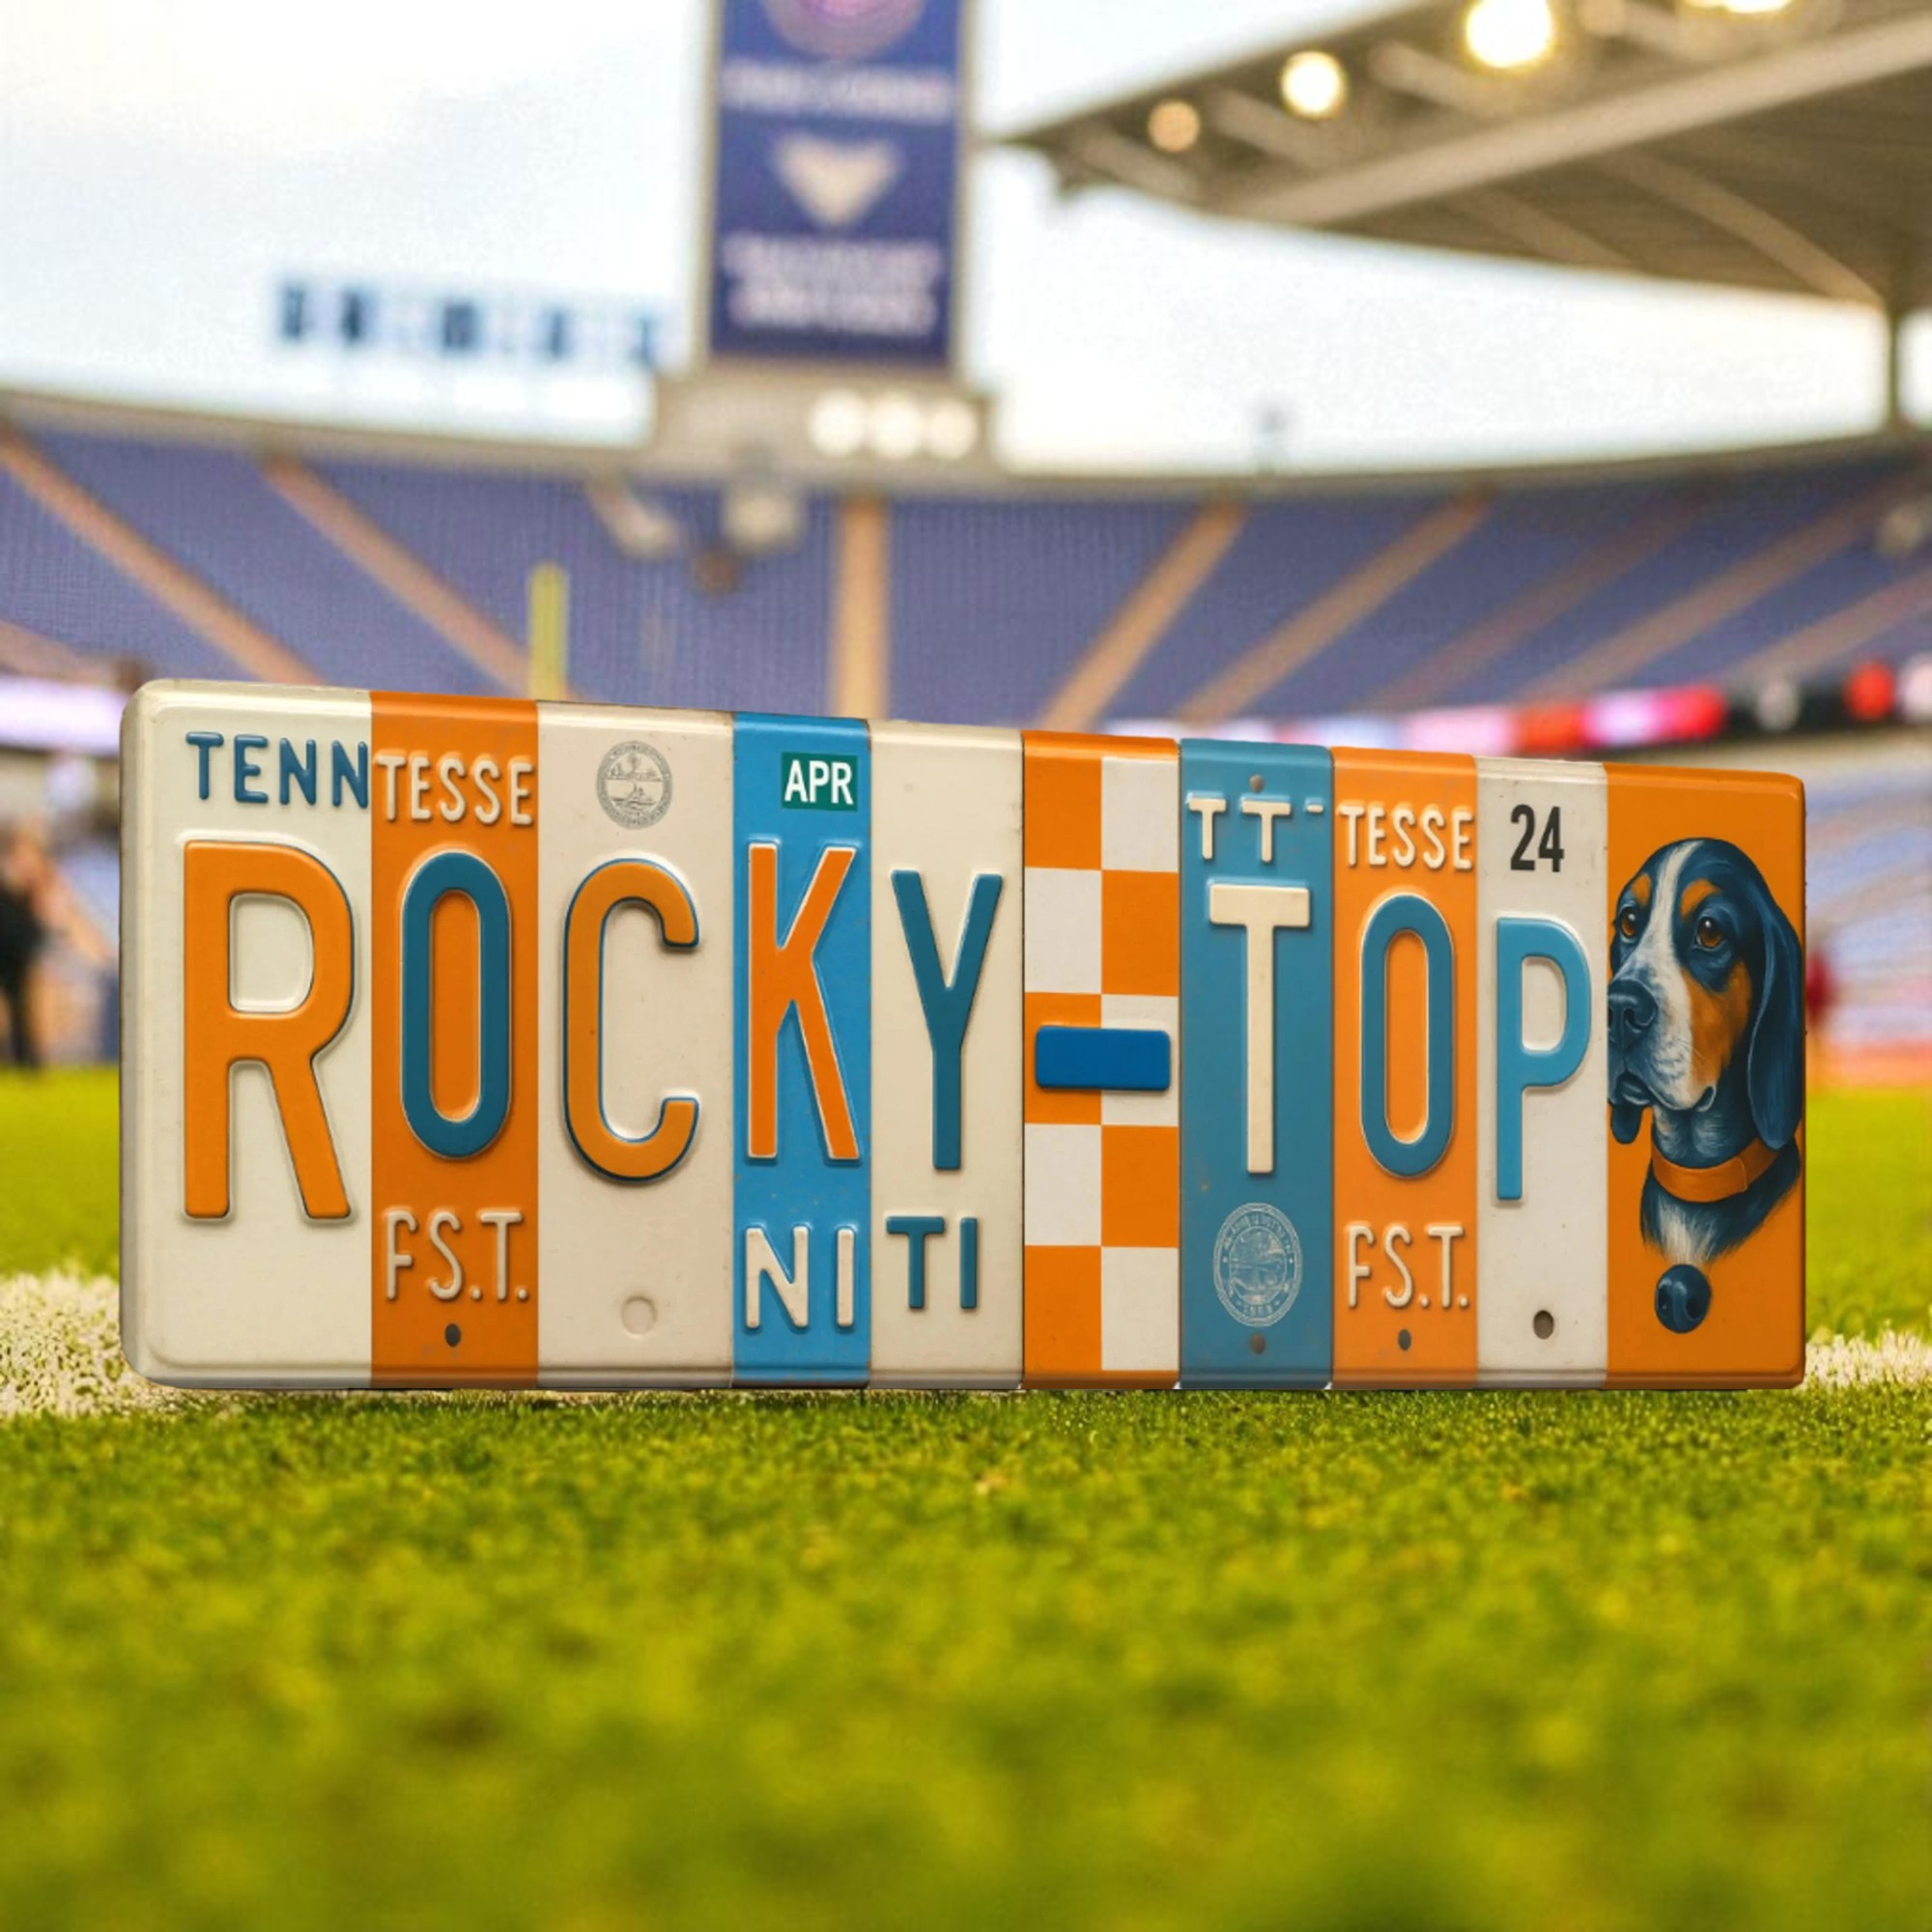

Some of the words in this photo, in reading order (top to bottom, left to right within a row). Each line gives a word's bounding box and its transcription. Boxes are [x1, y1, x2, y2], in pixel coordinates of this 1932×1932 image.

[374, 750, 535, 826] TESSE
[784, 759, 854, 805] APR
[1339, 806, 1474, 869] TESSE
[1510, 804, 1565, 872] 24
